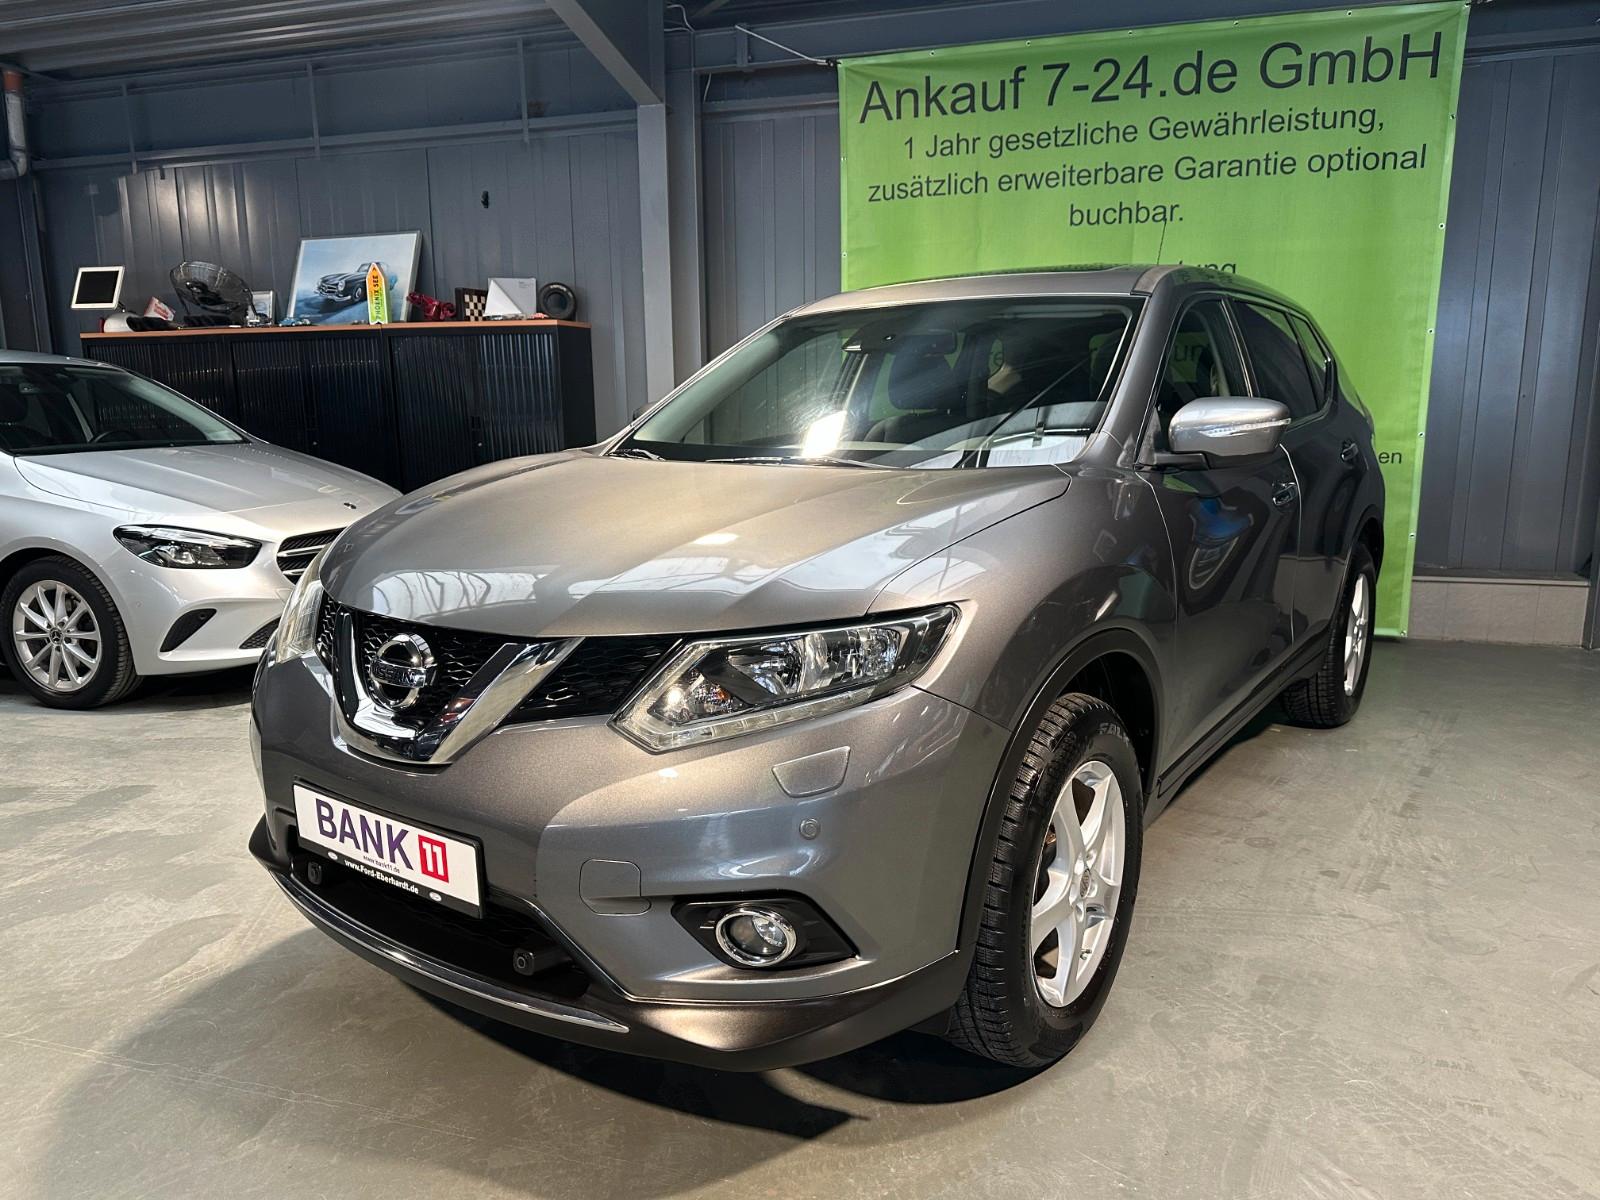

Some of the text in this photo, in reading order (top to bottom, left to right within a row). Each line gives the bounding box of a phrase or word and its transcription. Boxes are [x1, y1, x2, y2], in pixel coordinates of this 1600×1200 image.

[859, 31, 1442, 124] Ankauf 7-24.de GmbH
[904, 107, 1385, 160] 1 Jahr gesetzliche Gewährleistung,
[868, 143, 1427, 202] zusätzlich erweiterbare Garantie optional
[1069, 201, 1184, 227] buchbar.
[315, 798, 445, 876] BANK 11
[344, 859, 419, 894] www.Ford-Eberhardt.de
